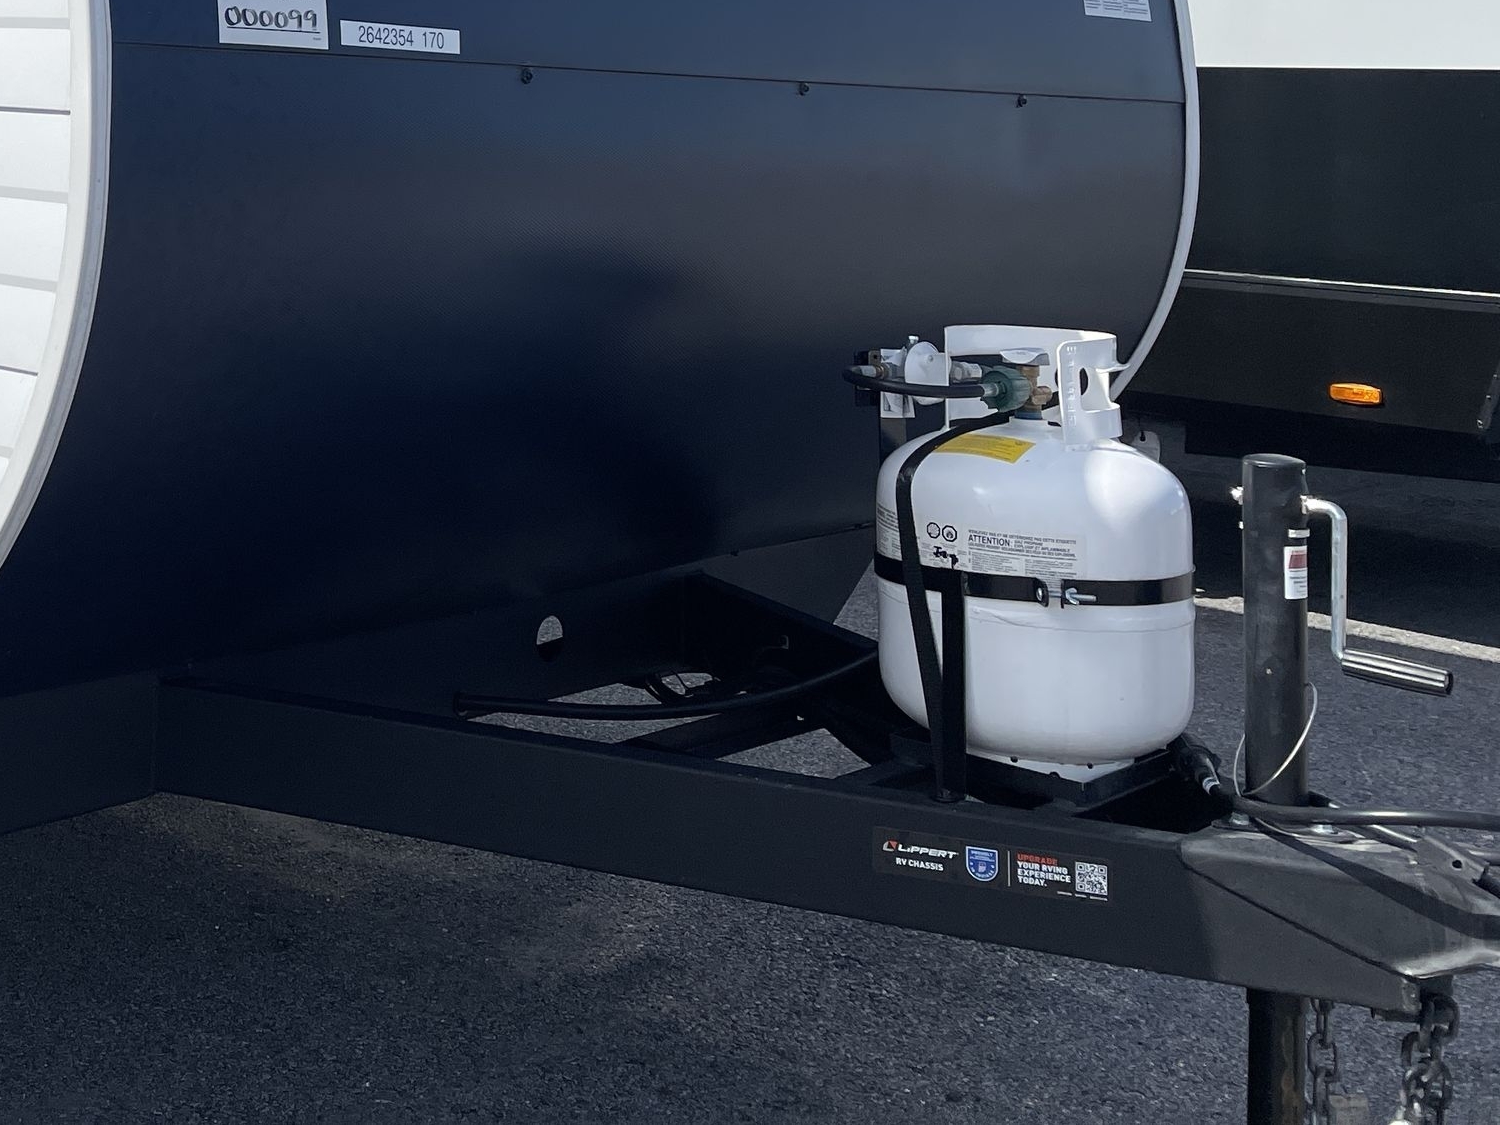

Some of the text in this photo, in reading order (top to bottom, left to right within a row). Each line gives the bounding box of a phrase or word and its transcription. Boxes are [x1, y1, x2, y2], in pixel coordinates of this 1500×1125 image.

[358, 25, 445, 50] 2642354 170
[968, 534, 1010, 547] ATTENTION
[895, 857, 944, 872] RV CHASSIS
[1017, 854, 1058, 866] UPGRADE
[1017, 861, 1068, 875] YOUR RVING
[1017, 868, 1071, 883] EXPERIENCE
[1017, 876, 1048, 887] TODAY.
